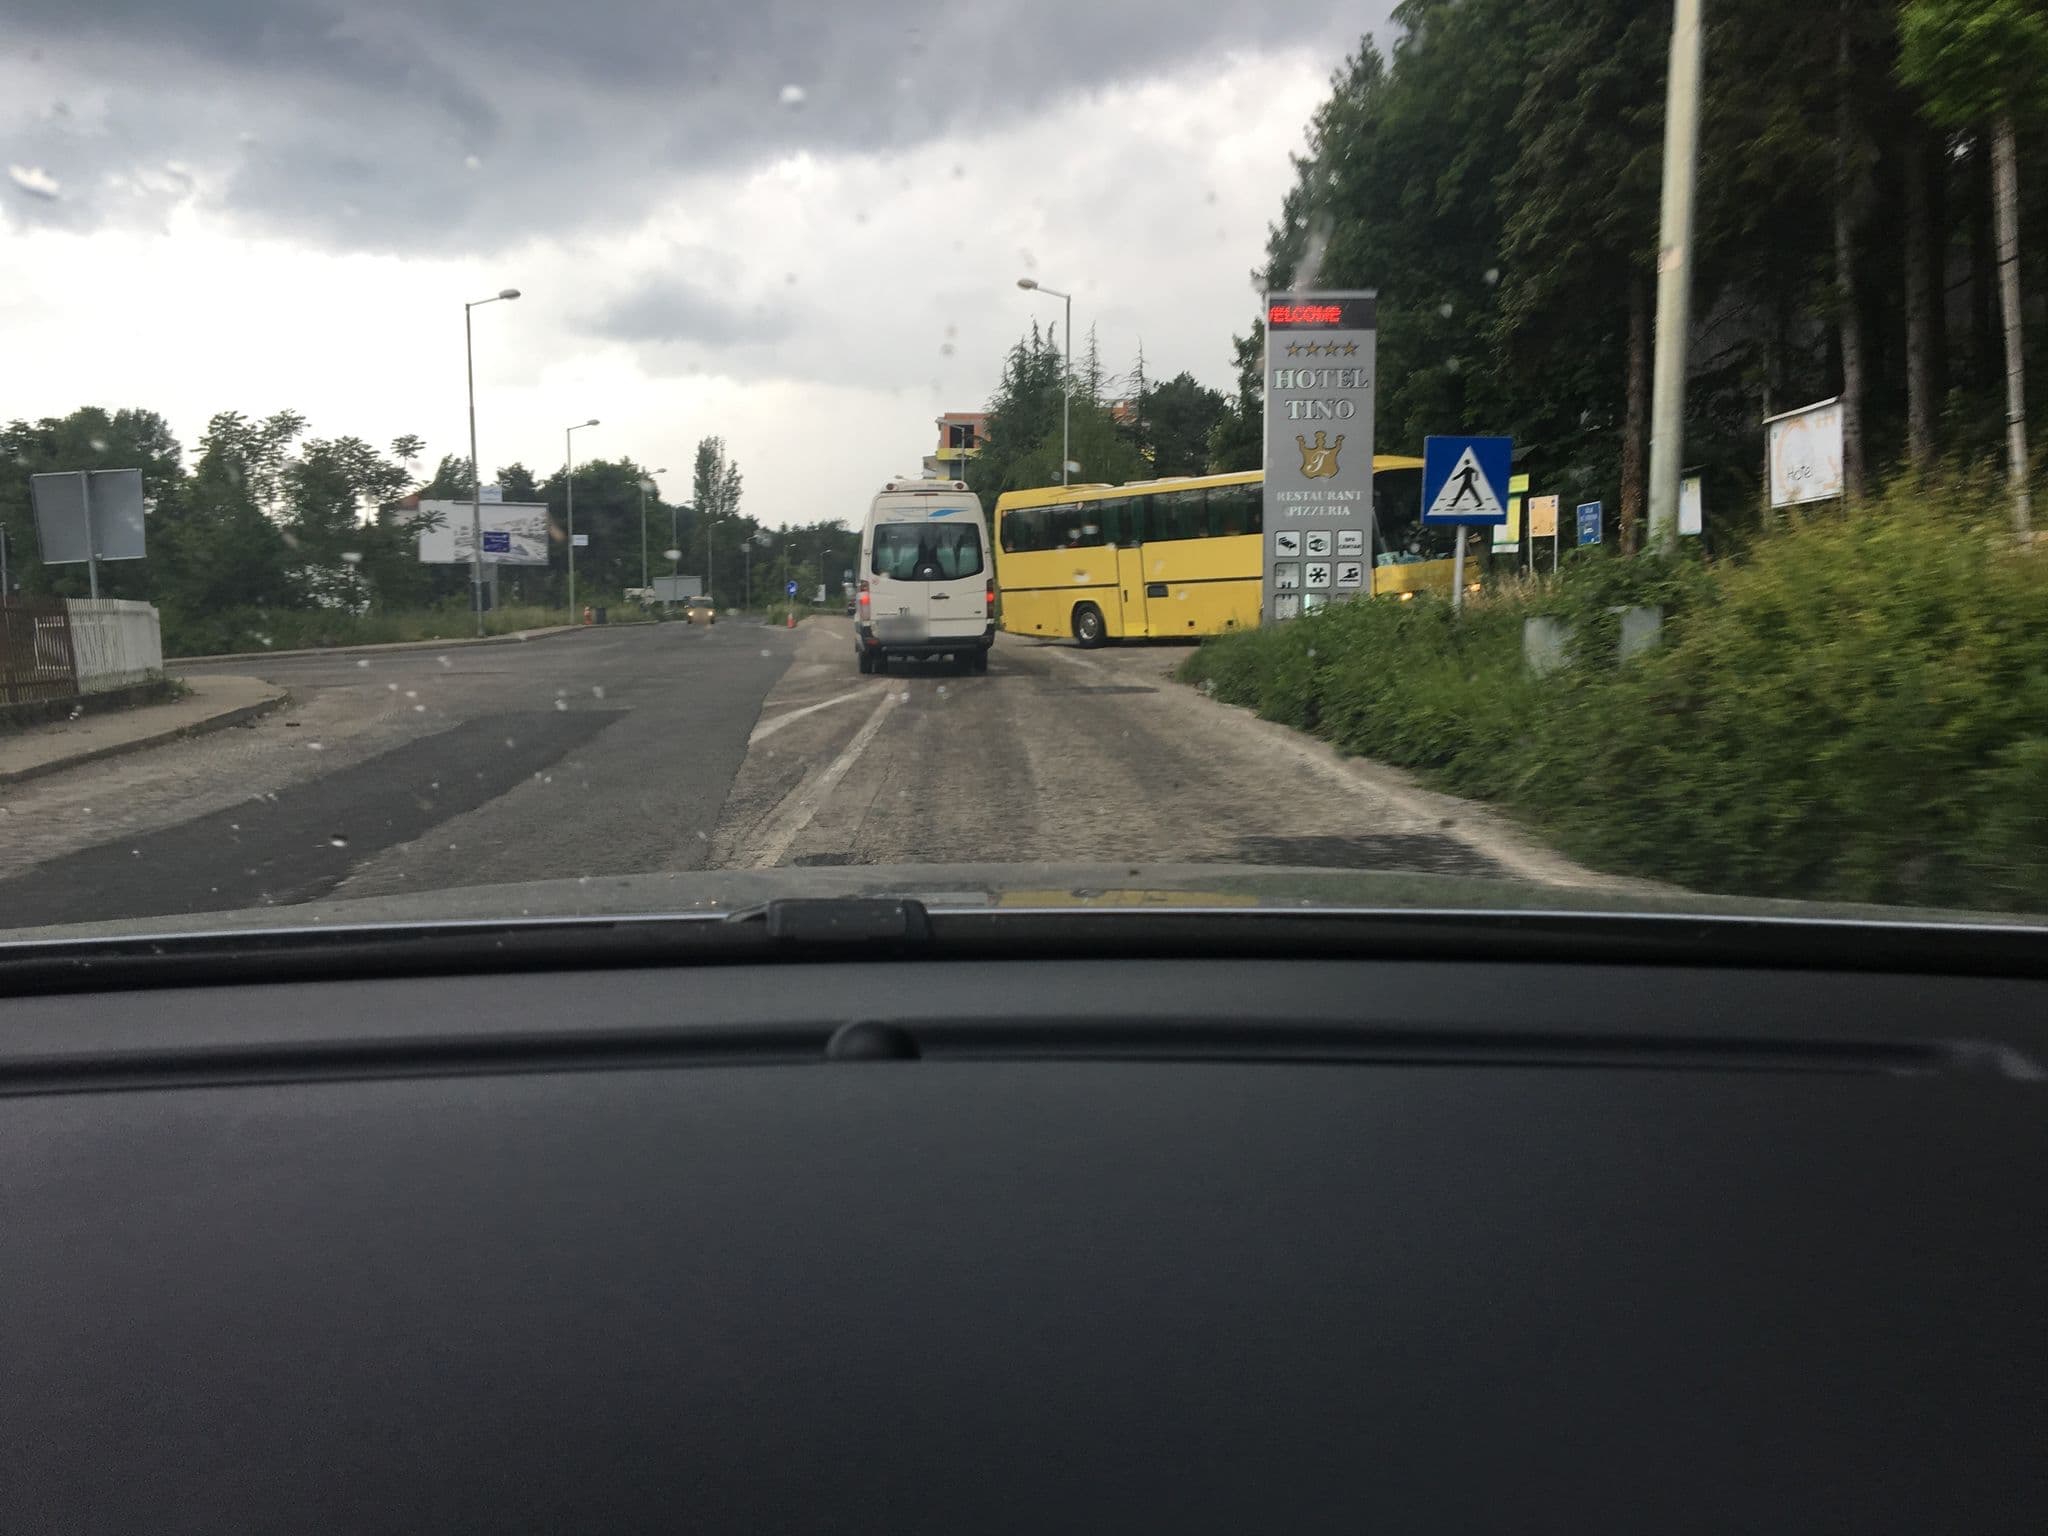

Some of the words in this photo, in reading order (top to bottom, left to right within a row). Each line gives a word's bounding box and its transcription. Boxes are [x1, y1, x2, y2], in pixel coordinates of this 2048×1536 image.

[1273, 368, 1368, 389] HOTEL
[1285, 399, 1355, 419] TINO
[1276, 490, 1362, 501] RESTAURANT
[1288, 505, 1351, 516] PIZZERIA
